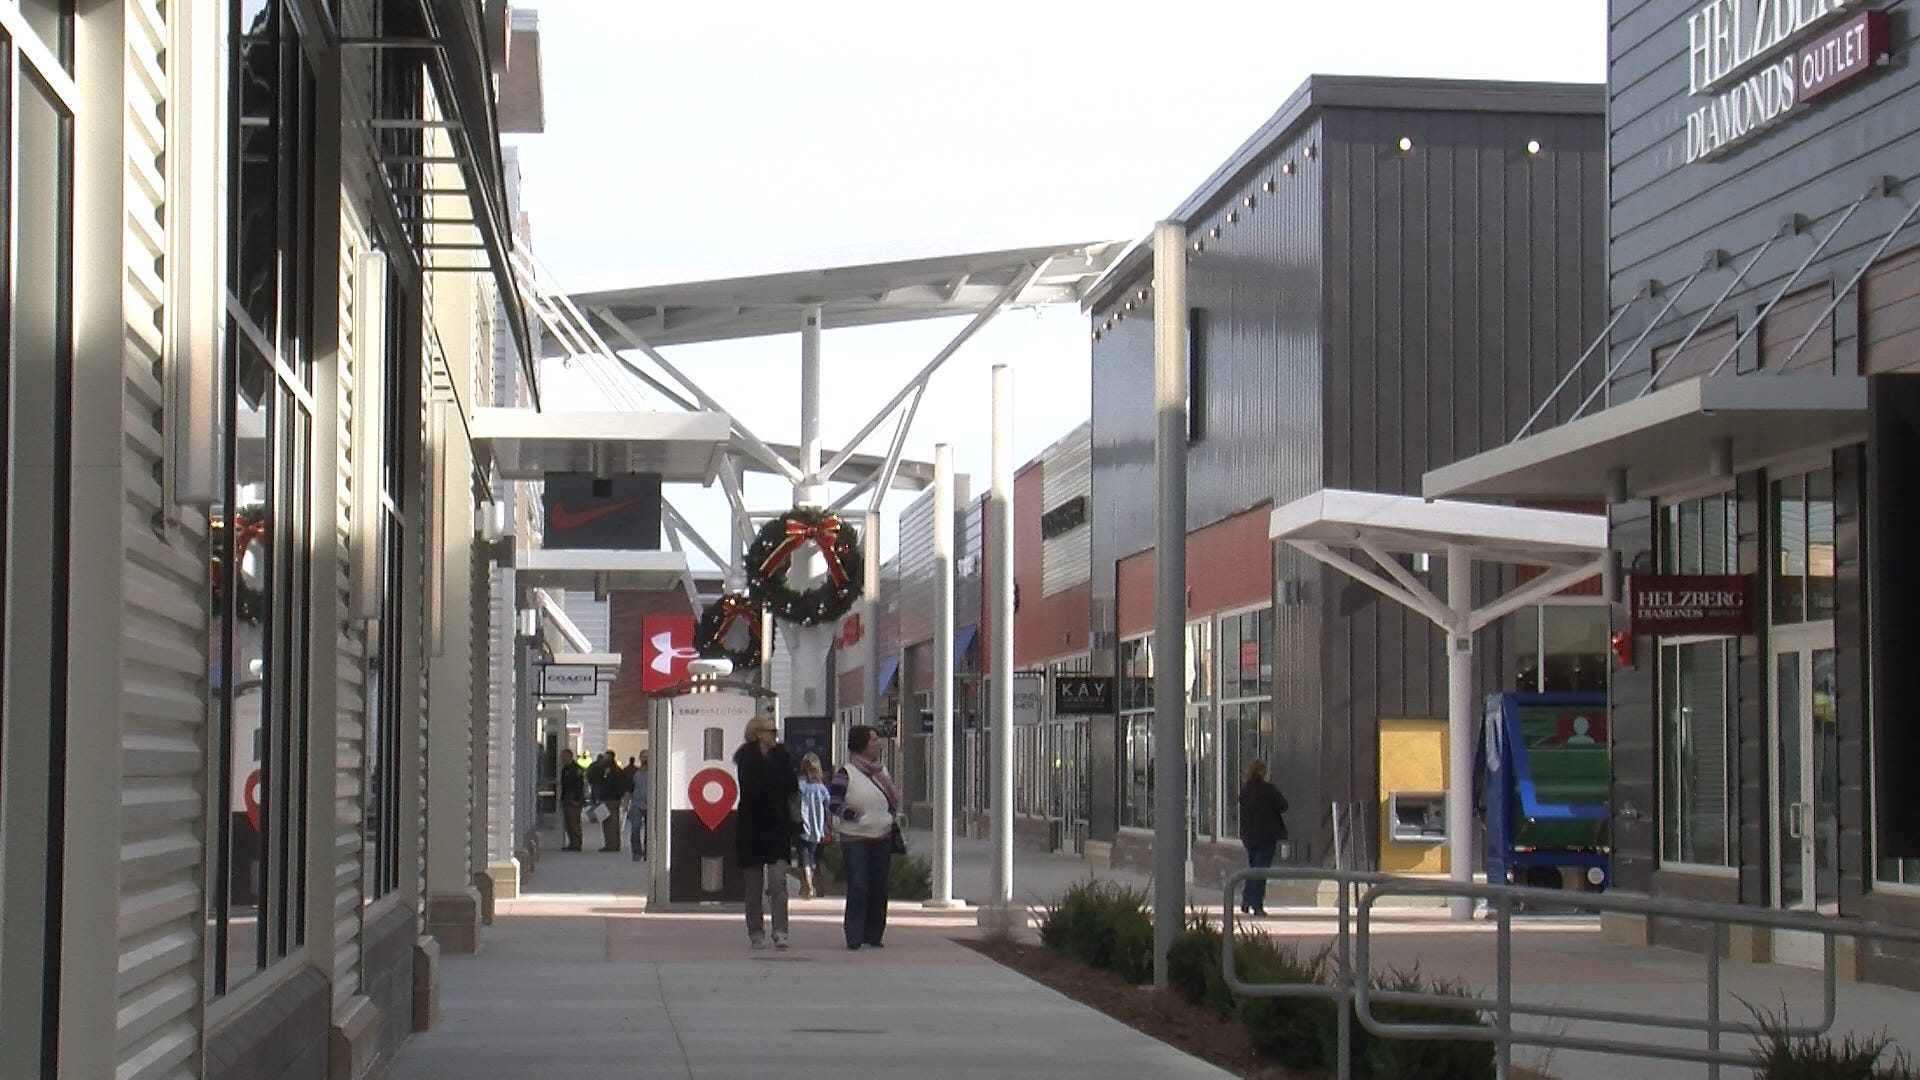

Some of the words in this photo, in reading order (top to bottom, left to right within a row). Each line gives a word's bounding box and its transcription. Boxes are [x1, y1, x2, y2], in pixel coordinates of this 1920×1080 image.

[1686, 54, 1795, 164] DIAMONDS
[1802, 23, 1865, 90] OUTLET
[1639, 591, 1744, 607] HELZBERG
[1638, 608, 1704, 619] DIAMONDS
[548, 674, 592, 682] COACH
[1062, 683, 1105, 696] KAY
